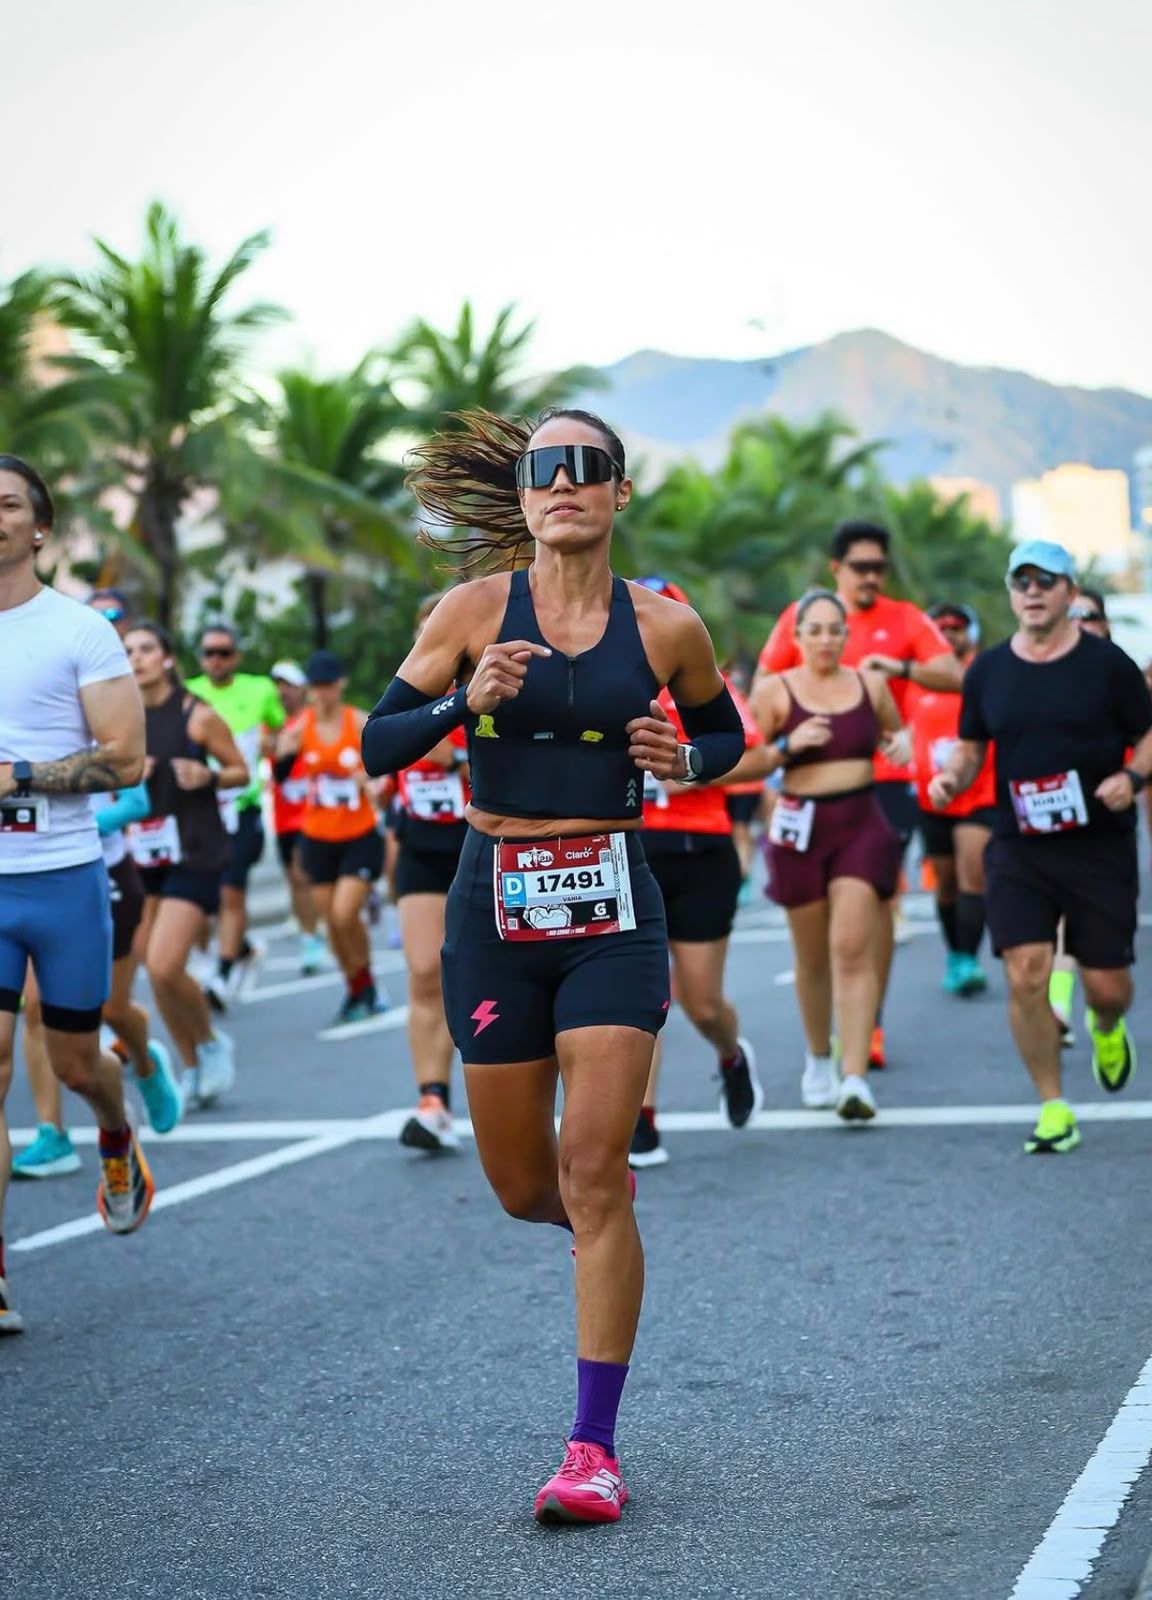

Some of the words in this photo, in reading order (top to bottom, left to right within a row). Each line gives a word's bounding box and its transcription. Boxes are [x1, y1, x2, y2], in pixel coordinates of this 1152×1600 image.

[565, 849, 591, 860] Claro
[506, 877, 523, 895] D
[537, 869, 605, 893] 17491
[594, 902, 607, 916] G
